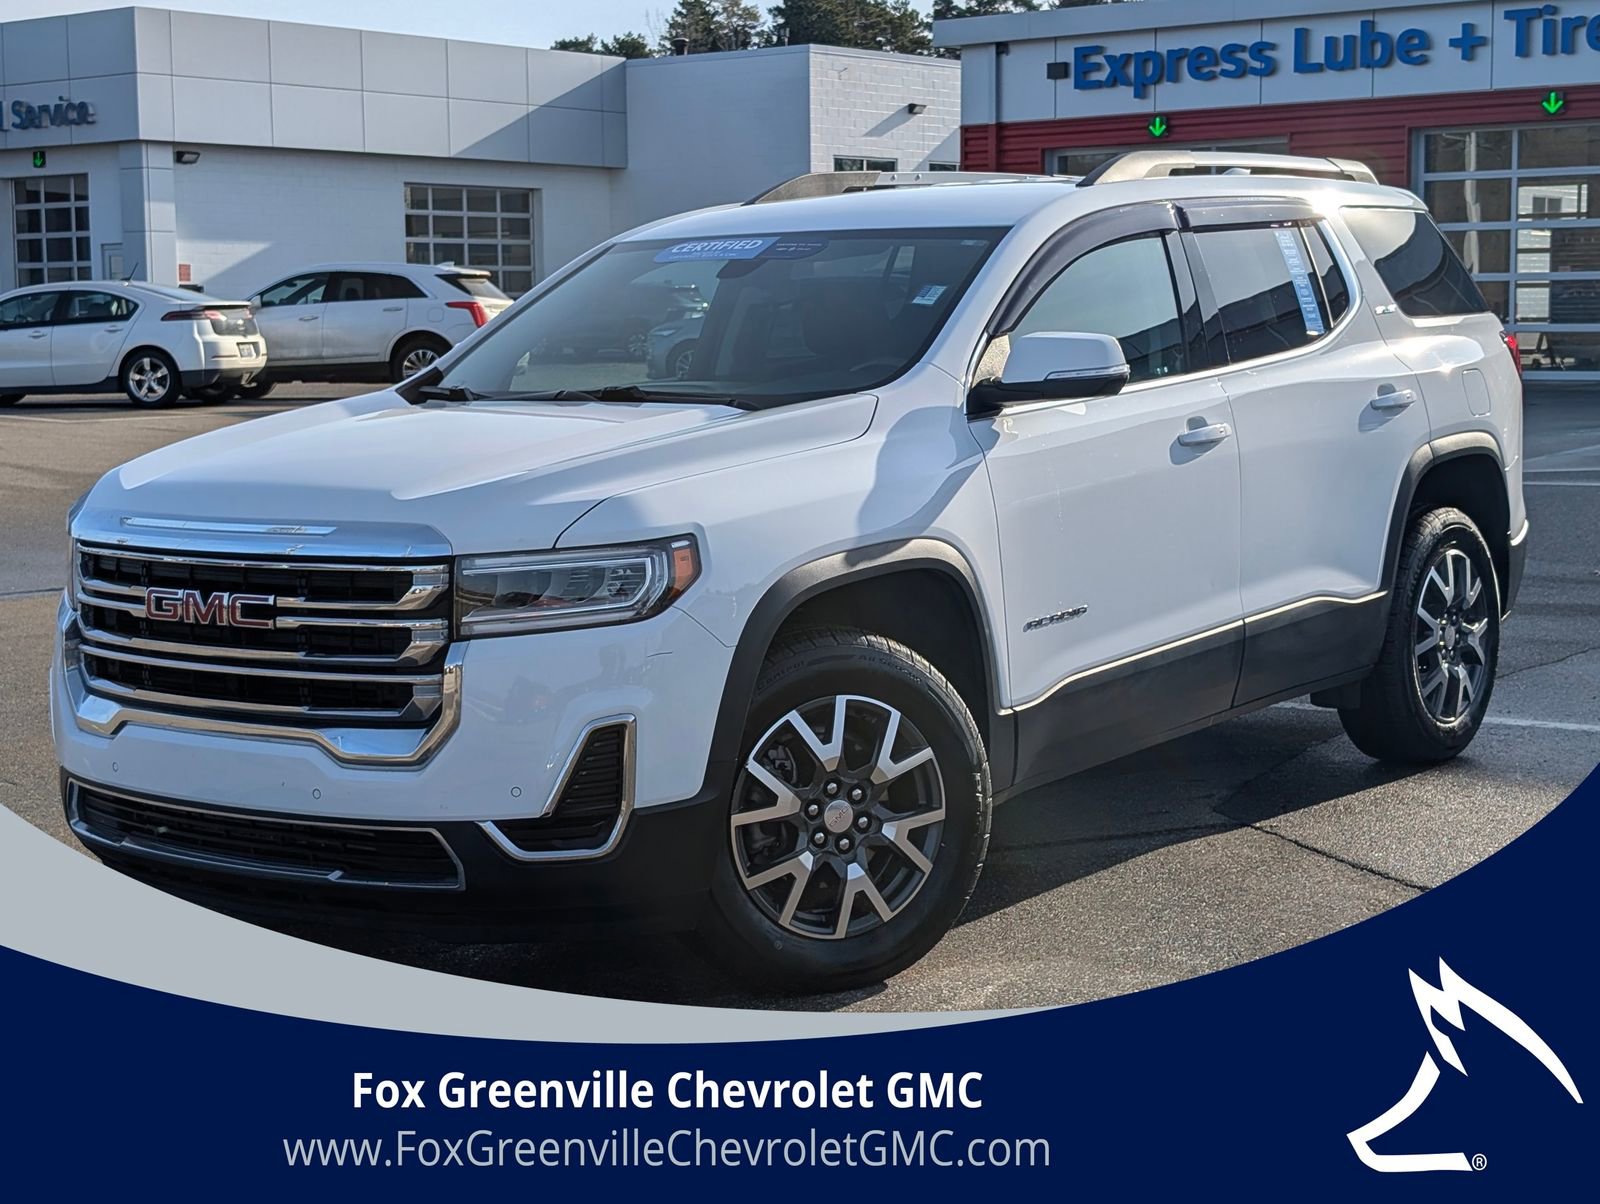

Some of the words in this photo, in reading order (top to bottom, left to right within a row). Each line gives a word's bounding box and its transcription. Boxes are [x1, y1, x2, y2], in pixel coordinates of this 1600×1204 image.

[1073, 40, 1278, 99] Express
[1293, 19, 1432, 74] Lube
[1448, 22, 1487, 62] +
[11, 96, 96, 130] Service
[671, 239, 763, 253] CERTIFIED
[145, 586, 275, 630] GMC
[829, 805, 850, 827] GMC
